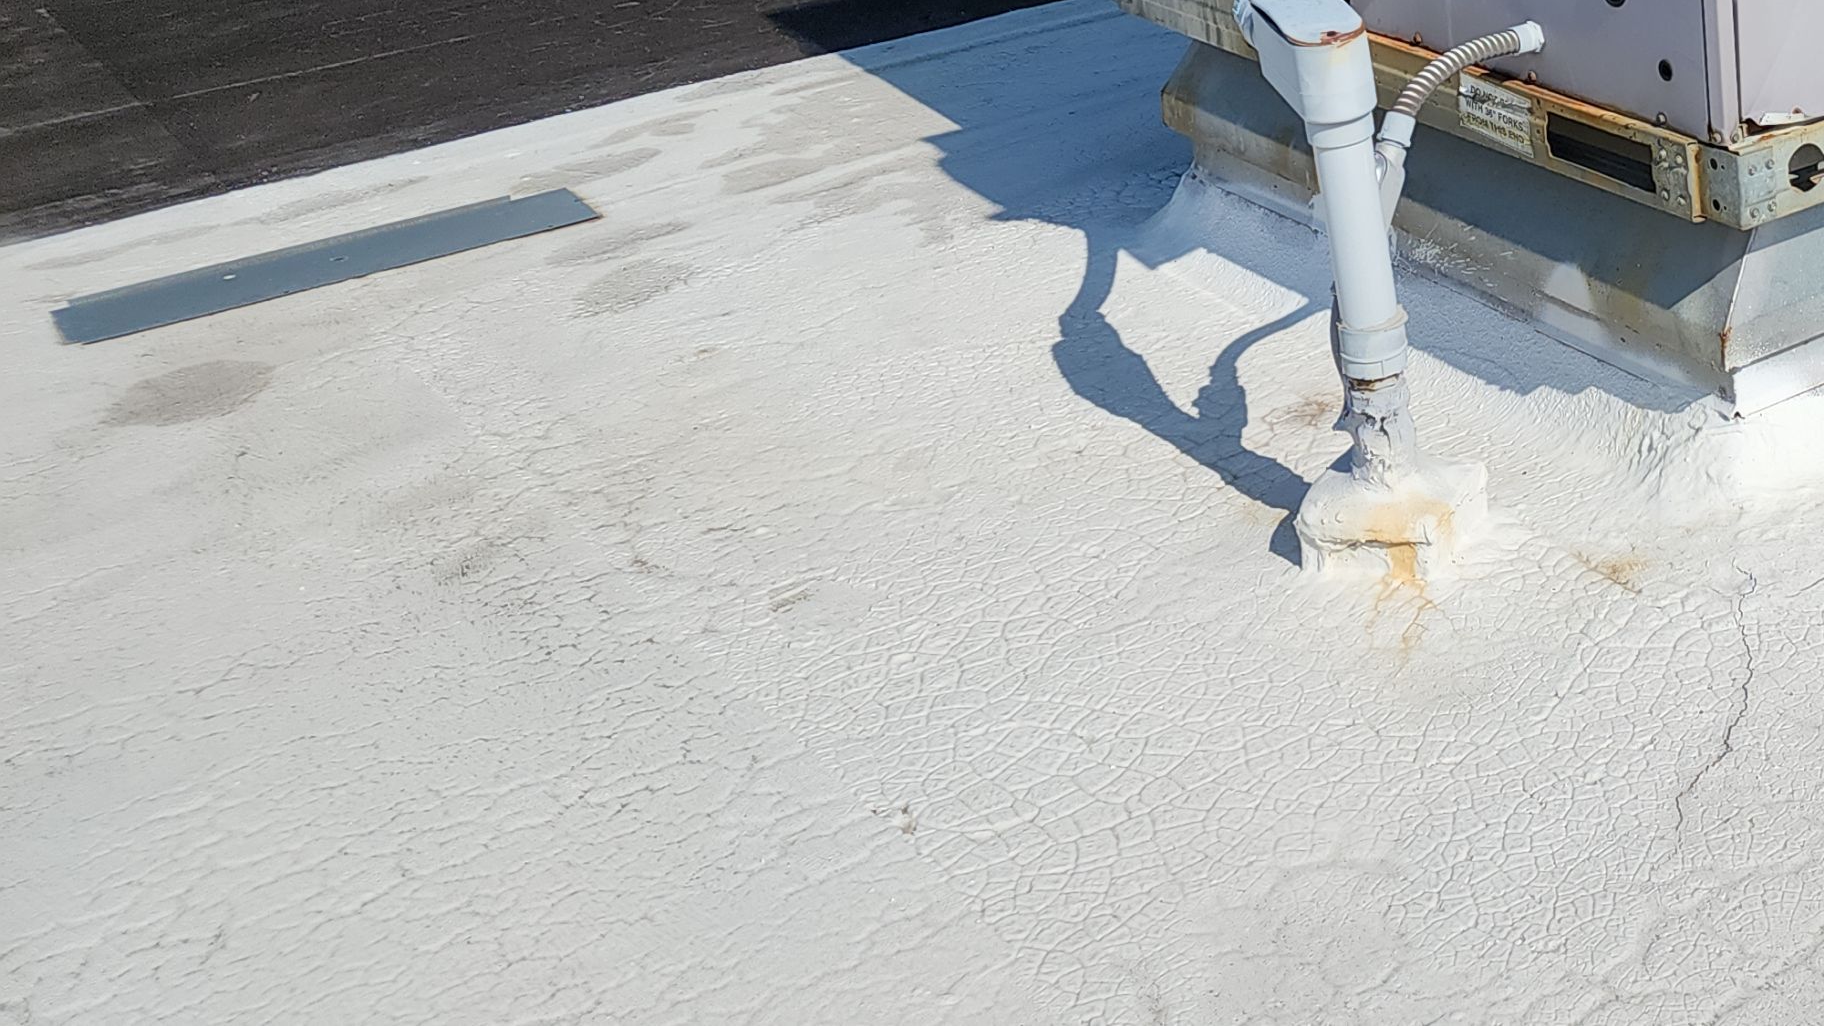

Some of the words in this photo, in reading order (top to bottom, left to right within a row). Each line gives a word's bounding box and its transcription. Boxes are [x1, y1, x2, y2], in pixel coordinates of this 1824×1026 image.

[1470, 84, 1481, 96] DO
[1465, 98, 1483, 113] WITH
[1465, 112, 1489, 128] FROM
[1489, 121, 1507, 137] THIS
[1508, 130, 1525, 144] END
